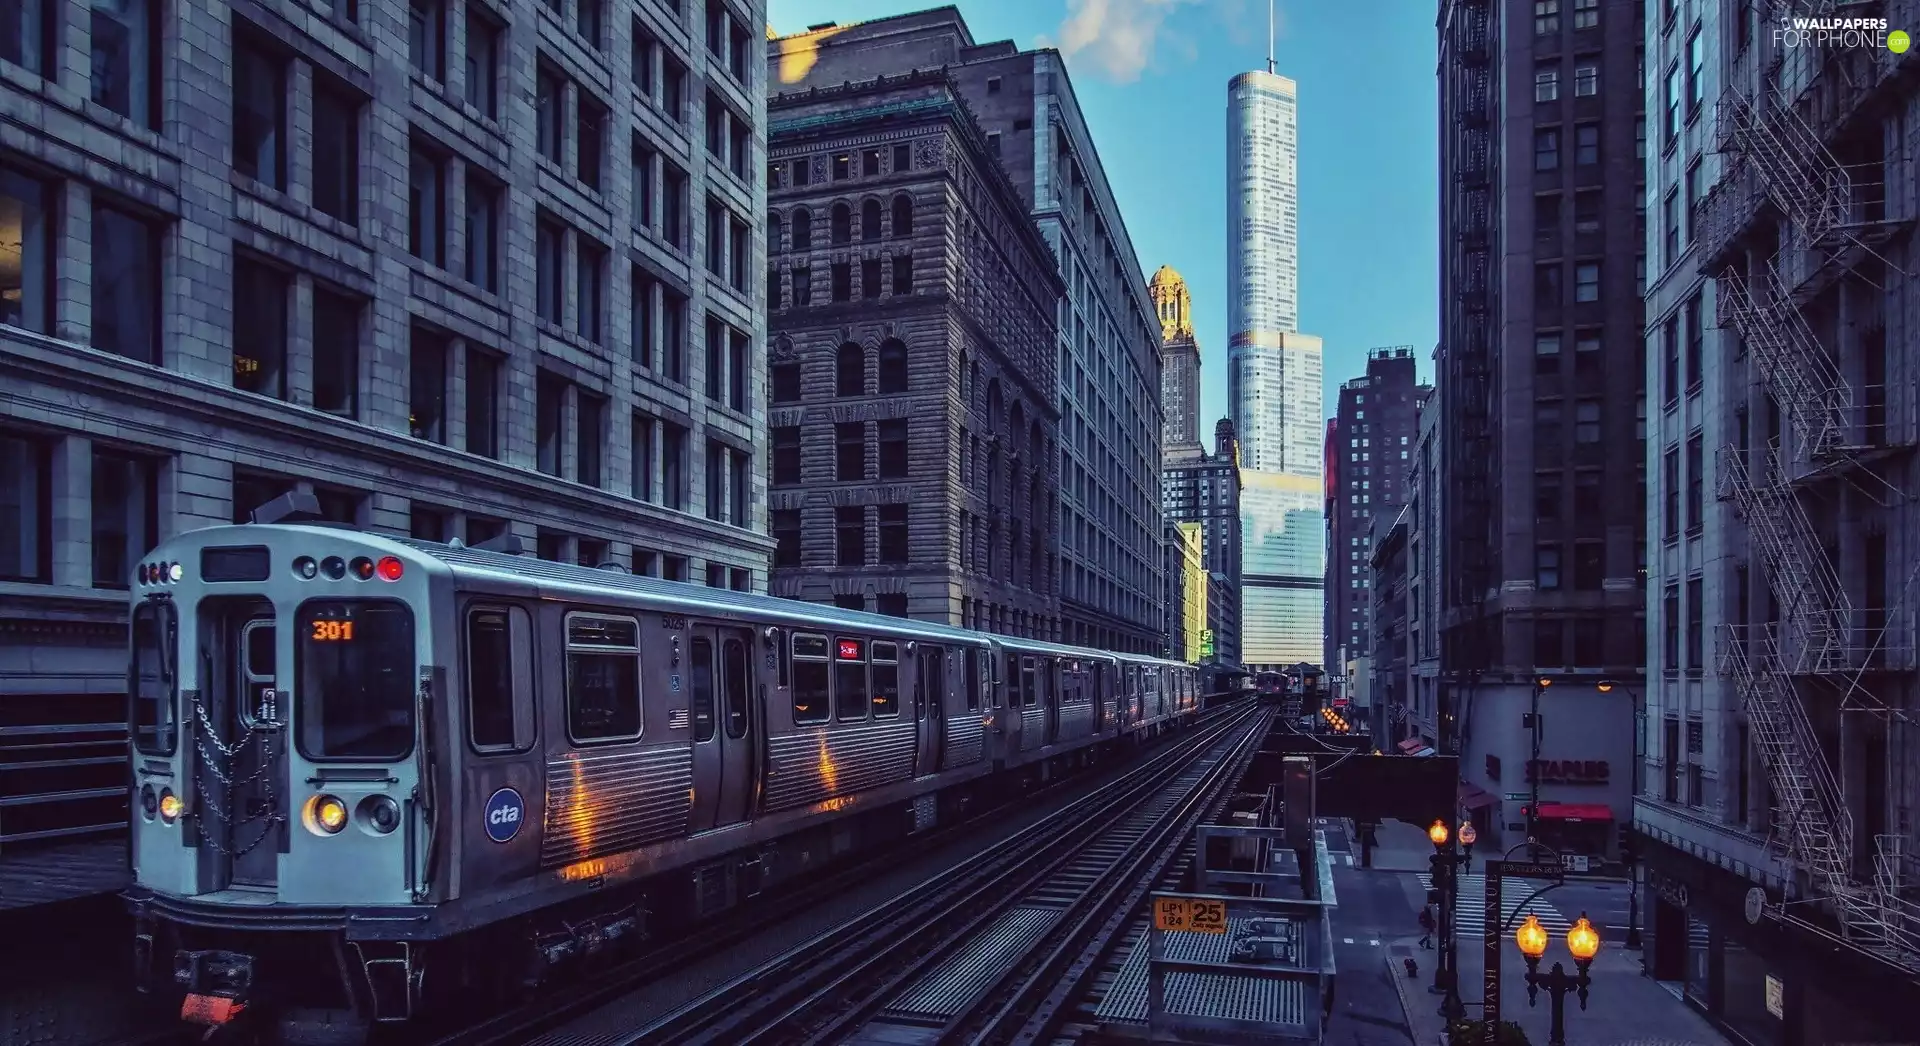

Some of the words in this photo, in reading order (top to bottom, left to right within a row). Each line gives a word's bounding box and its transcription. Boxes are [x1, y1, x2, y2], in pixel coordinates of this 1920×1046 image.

[311, 621, 353, 640] 301
[490, 804, 519, 825] cta
[1162, 902, 1183, 914] LP1
[1194, 902, 1222, 922] 25
[1162, 915, 1183, 926] 124
